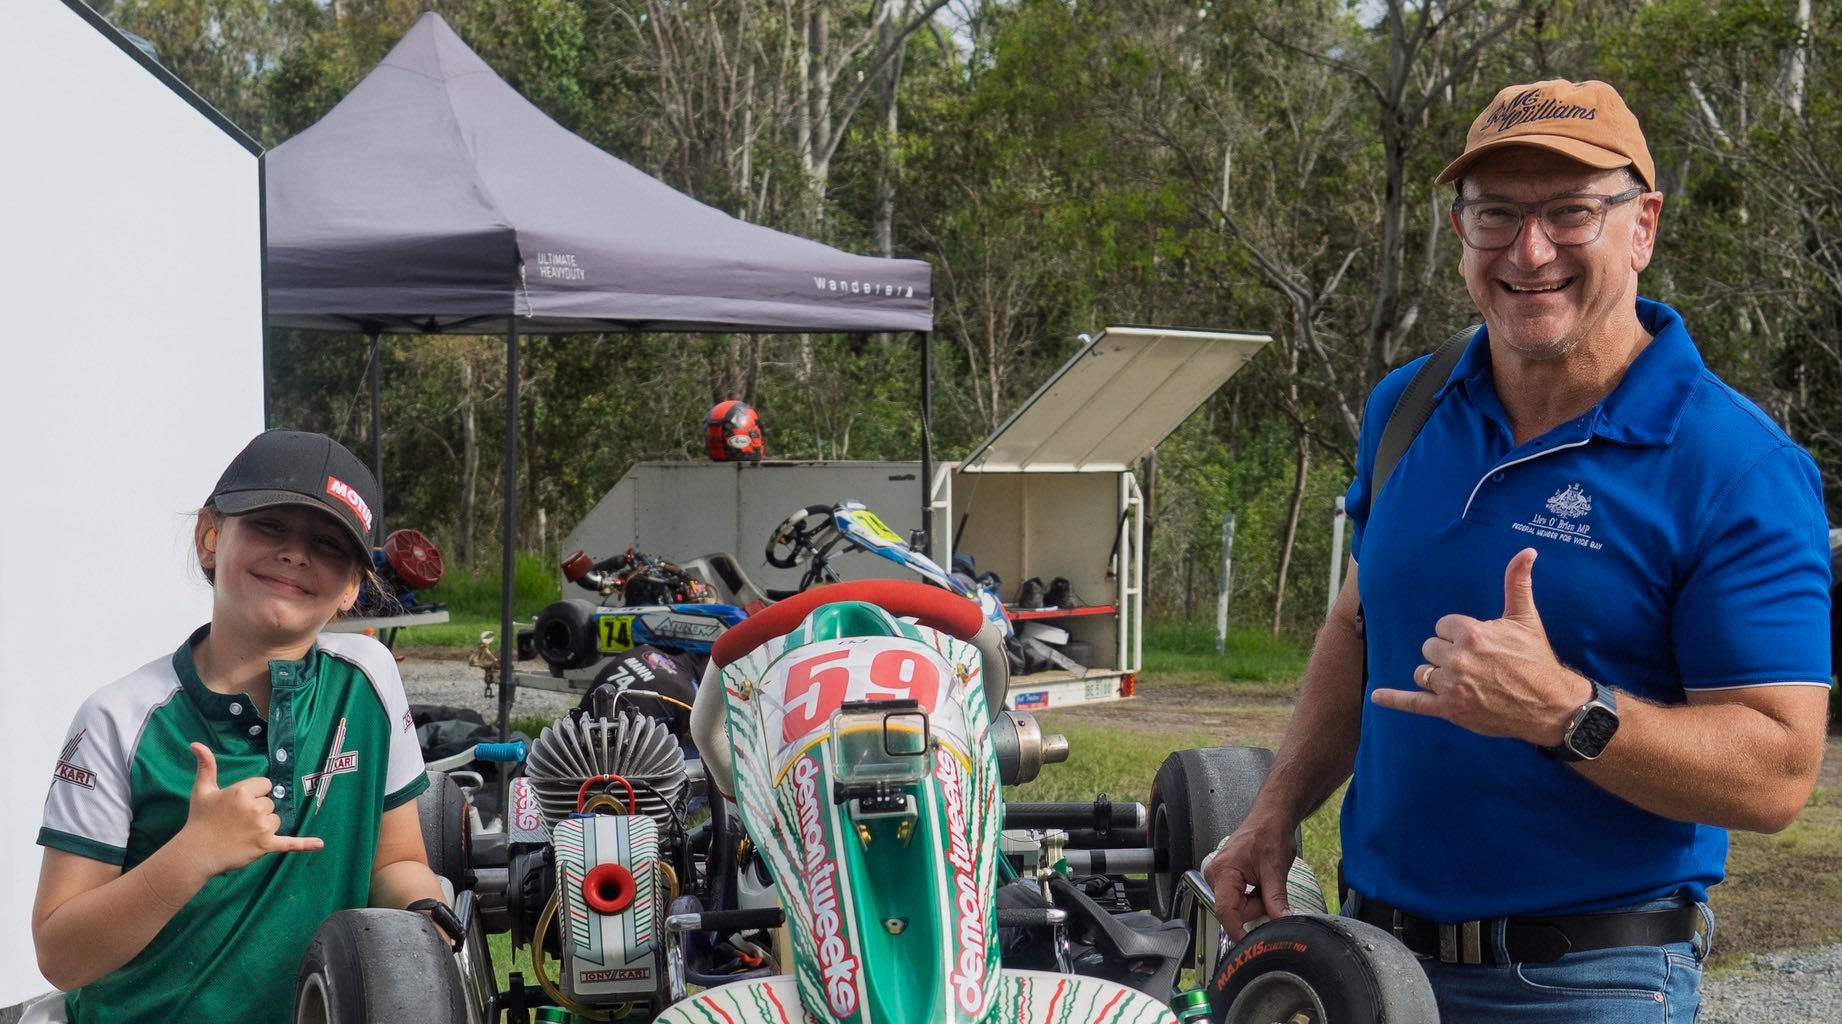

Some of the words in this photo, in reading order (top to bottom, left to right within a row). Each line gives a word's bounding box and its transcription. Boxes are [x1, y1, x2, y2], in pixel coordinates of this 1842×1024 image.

[537, 252, 577, 267] ULTIMATE
[540, 266, 585, 280] HEAVYDUTY
[814, 276, 902, 297] Wanderer
[330, 480, 373, 530] MOTUL
[1559, 533, 1573, 543] FOR
[604, 621, 631, 648] 74
[783, 649, 940, 743] 59
[61, 764, 94, 784] KART
[1217, 941, 1265, 991] MAXXIS
